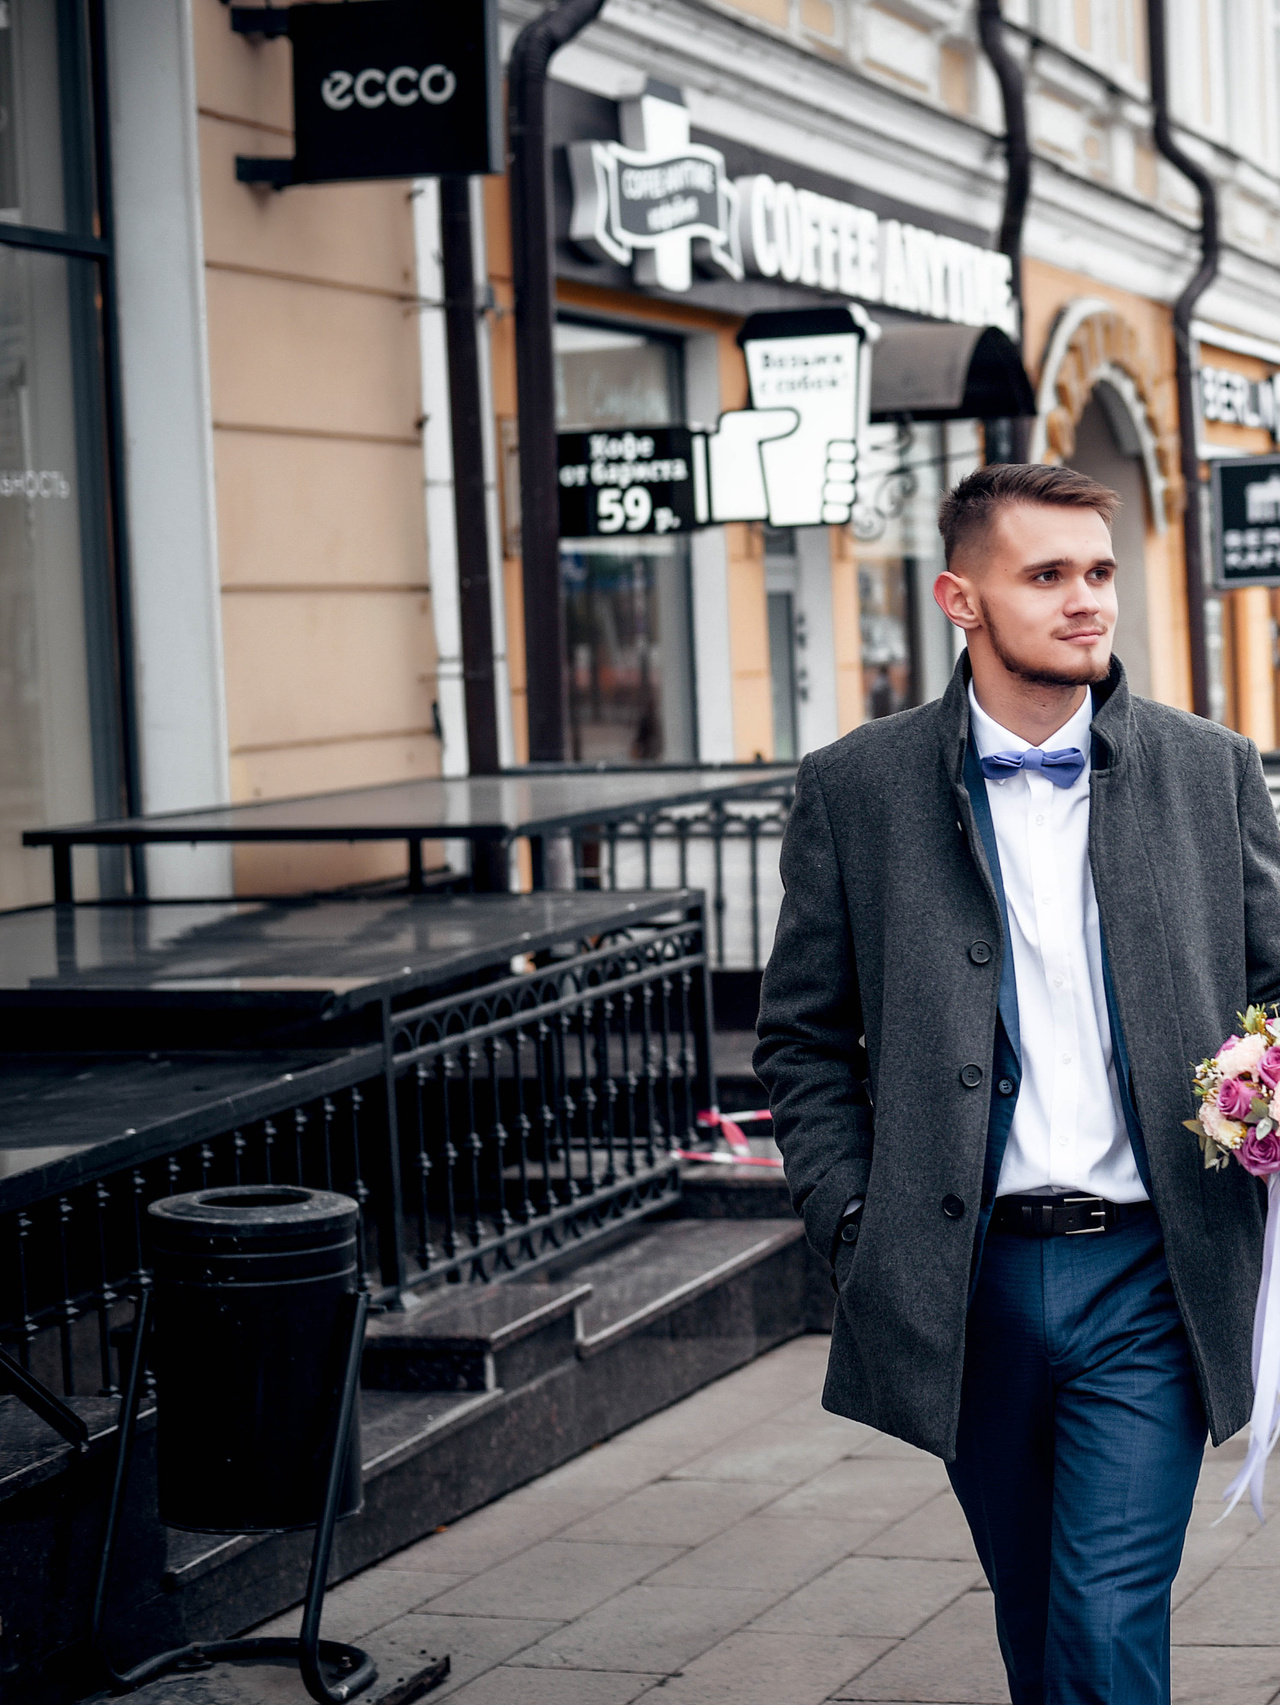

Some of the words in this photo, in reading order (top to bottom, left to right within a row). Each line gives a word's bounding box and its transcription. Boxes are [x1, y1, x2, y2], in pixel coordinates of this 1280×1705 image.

[321, 64, 457, 111] ecco
[750, 174, 883, 302] COFFEE
[882, 218, 1020, 343] ANYTIME
[1201, 365, 1275, 430] BERLIN
[589, 431, 656, 463] Кофе
[558, 464, 589, 488] от
[590, 457, 688, 489] бариста
[597, 485, 653, 534] 59
[653, 506, 682, 535] р.
